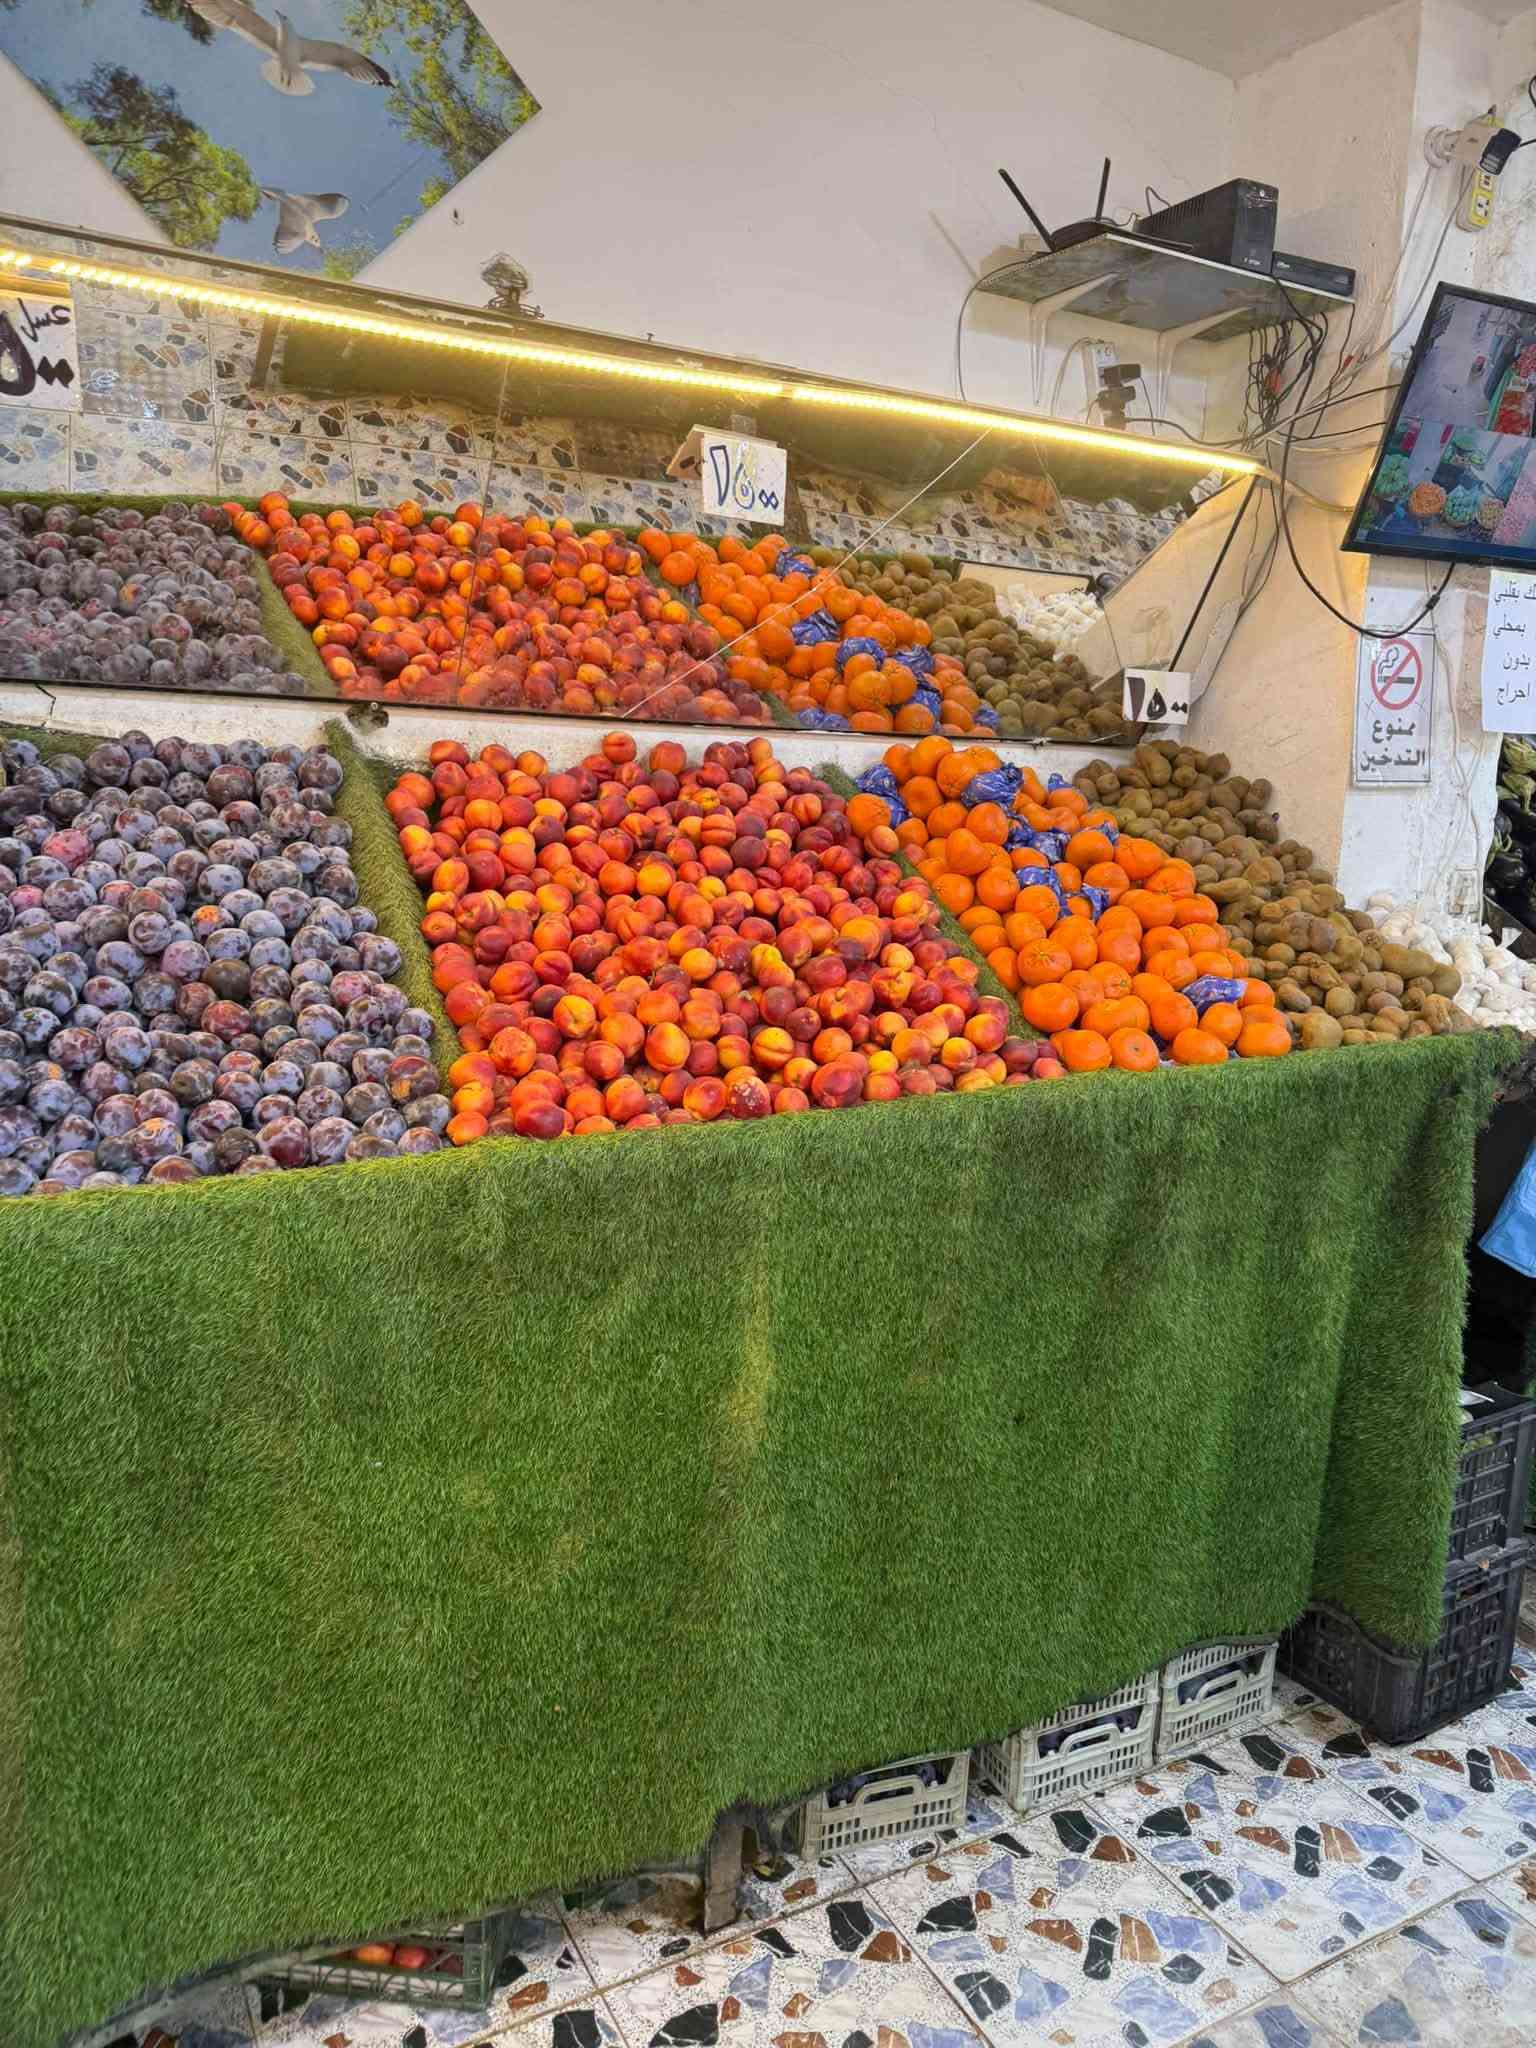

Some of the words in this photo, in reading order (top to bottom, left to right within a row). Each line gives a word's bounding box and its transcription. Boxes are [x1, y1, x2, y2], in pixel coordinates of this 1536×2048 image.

[17, 297, 71, 342] عسل
[1372, 718, 1416, 743] ممنوع
[1360, 749, 1426, 772] التدخين
